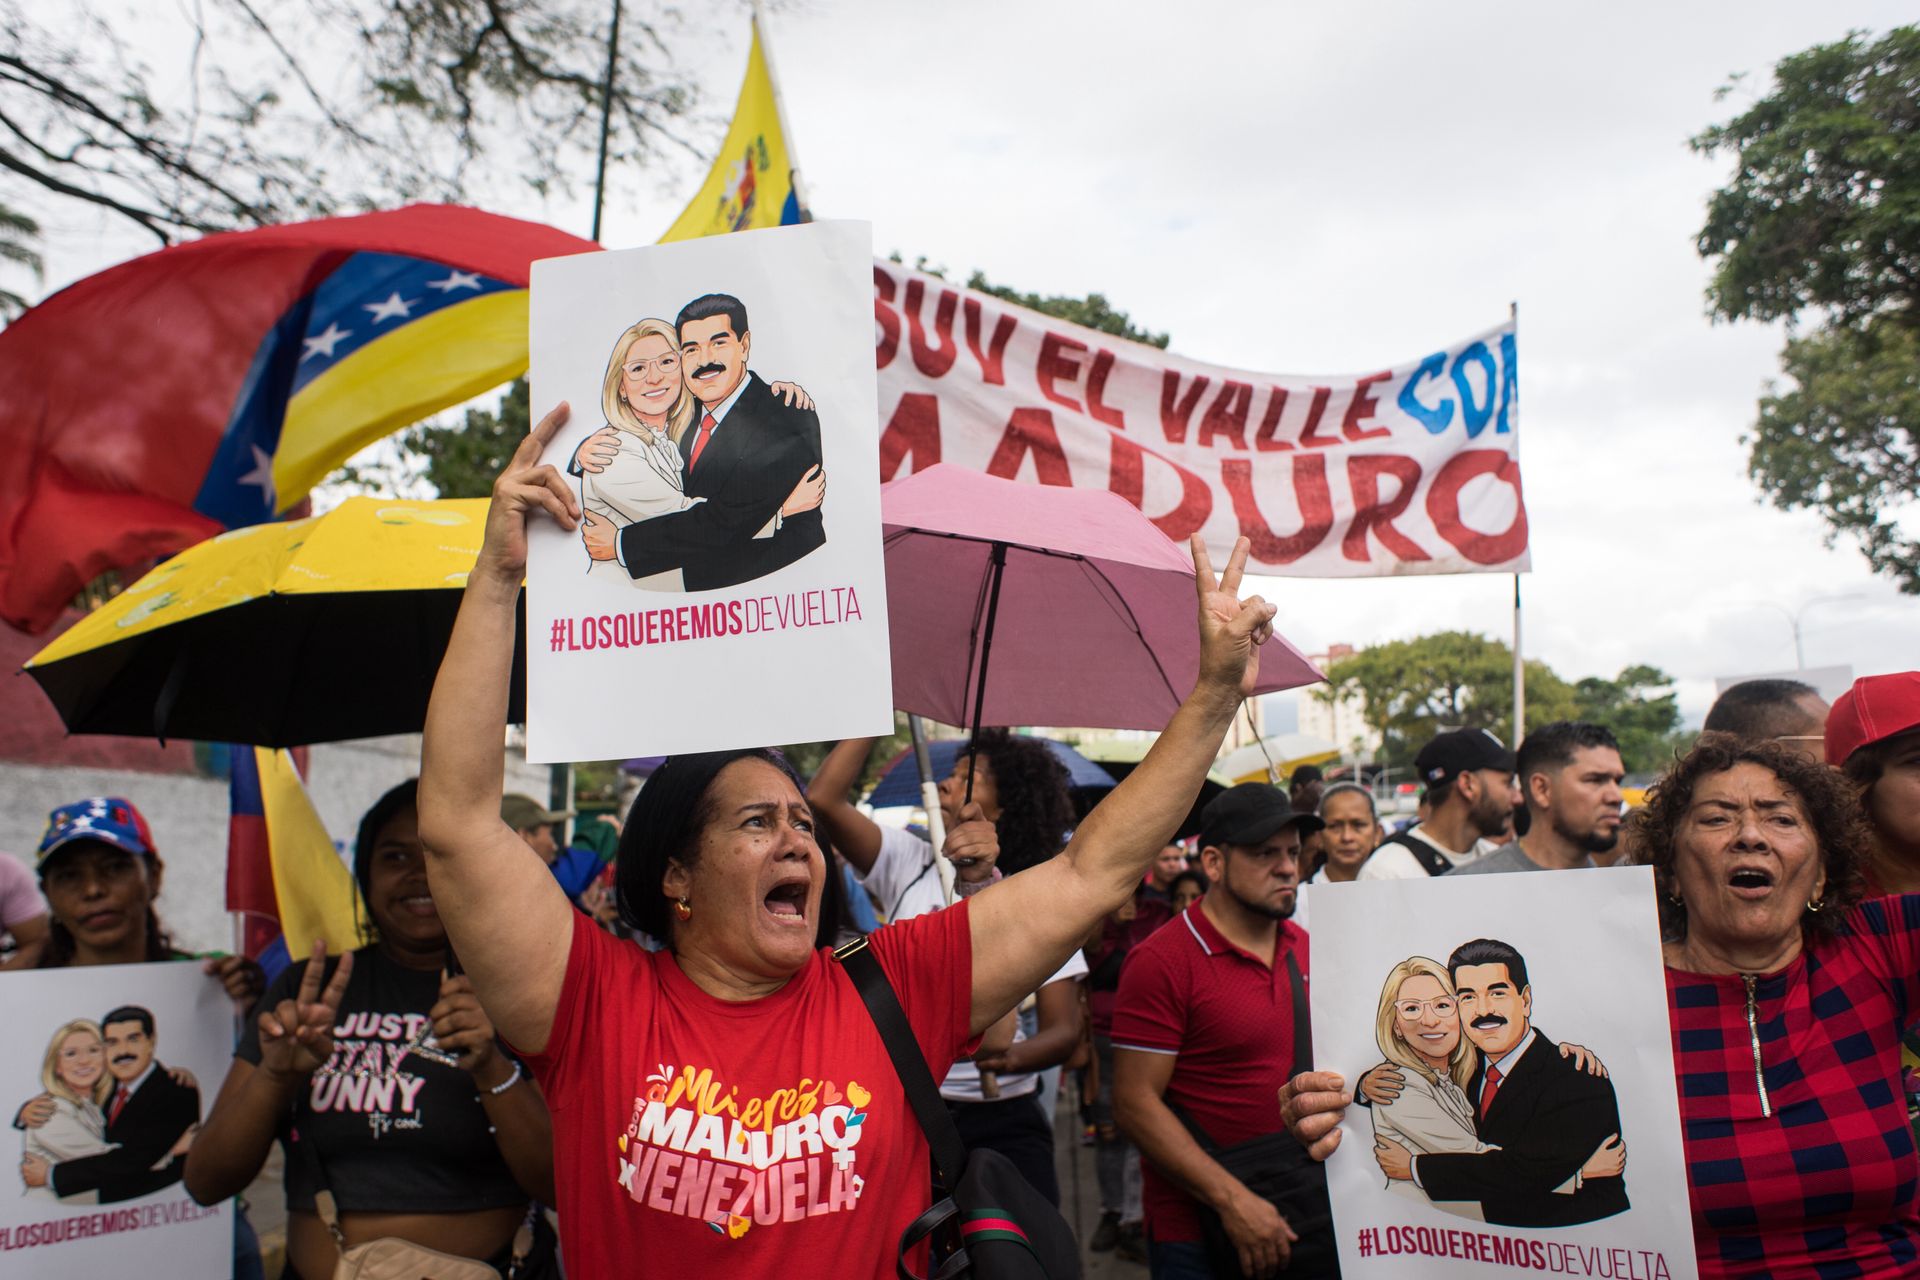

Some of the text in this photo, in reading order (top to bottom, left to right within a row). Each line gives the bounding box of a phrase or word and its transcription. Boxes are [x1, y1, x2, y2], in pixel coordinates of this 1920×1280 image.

[1036, 331, 1124, 429] EL
[1161, 369, 1392, 451] VALLE
[550, 586, 862, 652] #LOSQUEREMOSDEVUELTA
[333, 1011, 426, 1041] JUST
[637, 1101, 862, 1170] MADURO
[630, 1142, 857, 1226] VENEZUELA
[1358, 1225, 1671, 1280] #LOSQUEREMOSDEVUELTA
